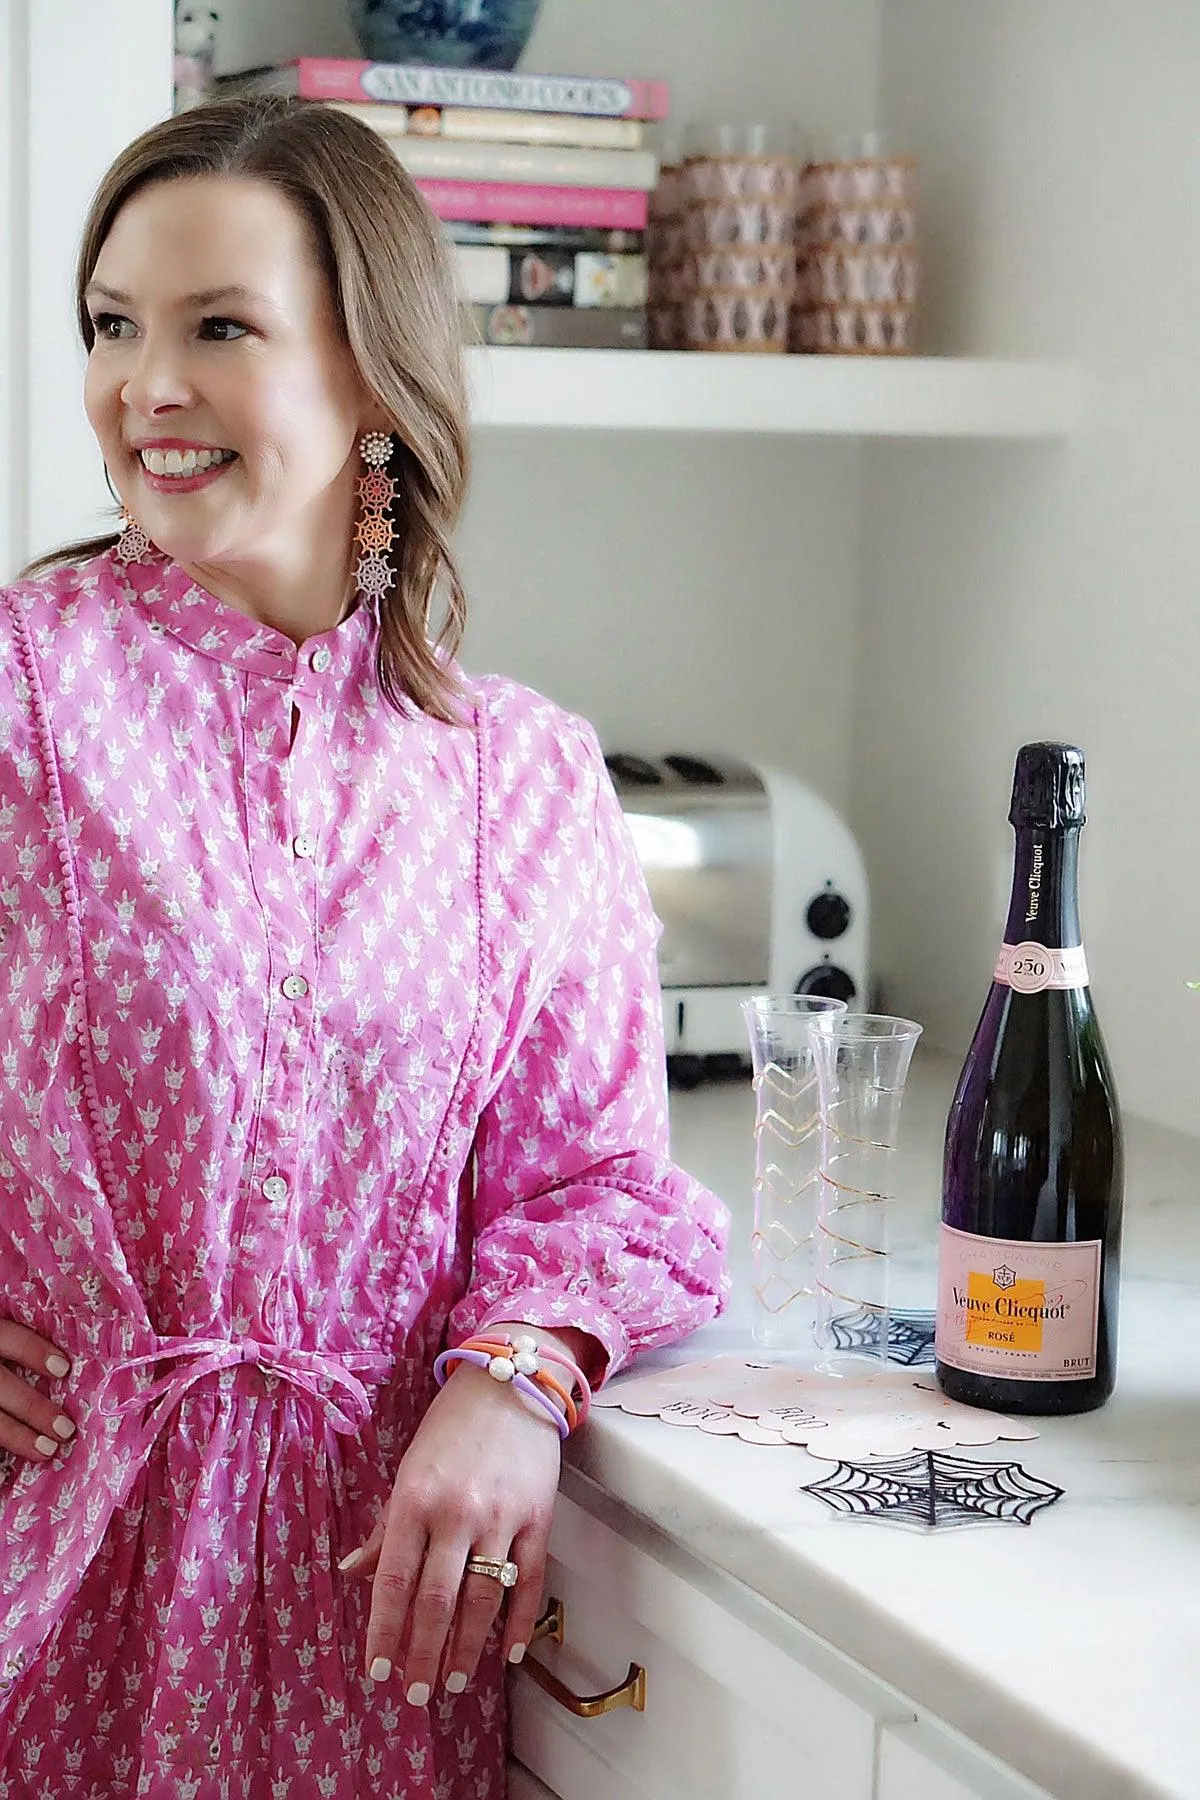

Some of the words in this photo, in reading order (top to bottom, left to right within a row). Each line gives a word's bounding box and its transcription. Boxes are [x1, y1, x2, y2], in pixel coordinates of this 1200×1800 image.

[376, 67, 422, 96] SAN
[1028, 844, 1044, 890] Clicquot
[1025, 892, 1040, 923] Veuve
[1013, 958, 1046, 977] 250
[959, 1249, 1063, 1273] CHAMPAGNE
[952, 1286, 991, 1313] Veuve
[995, 1297, 1067, 1323] Clicquot
[987, 1331, 1016, 1343] ROSÉ
[1063, 1357, 1091, 1368] BRUT
